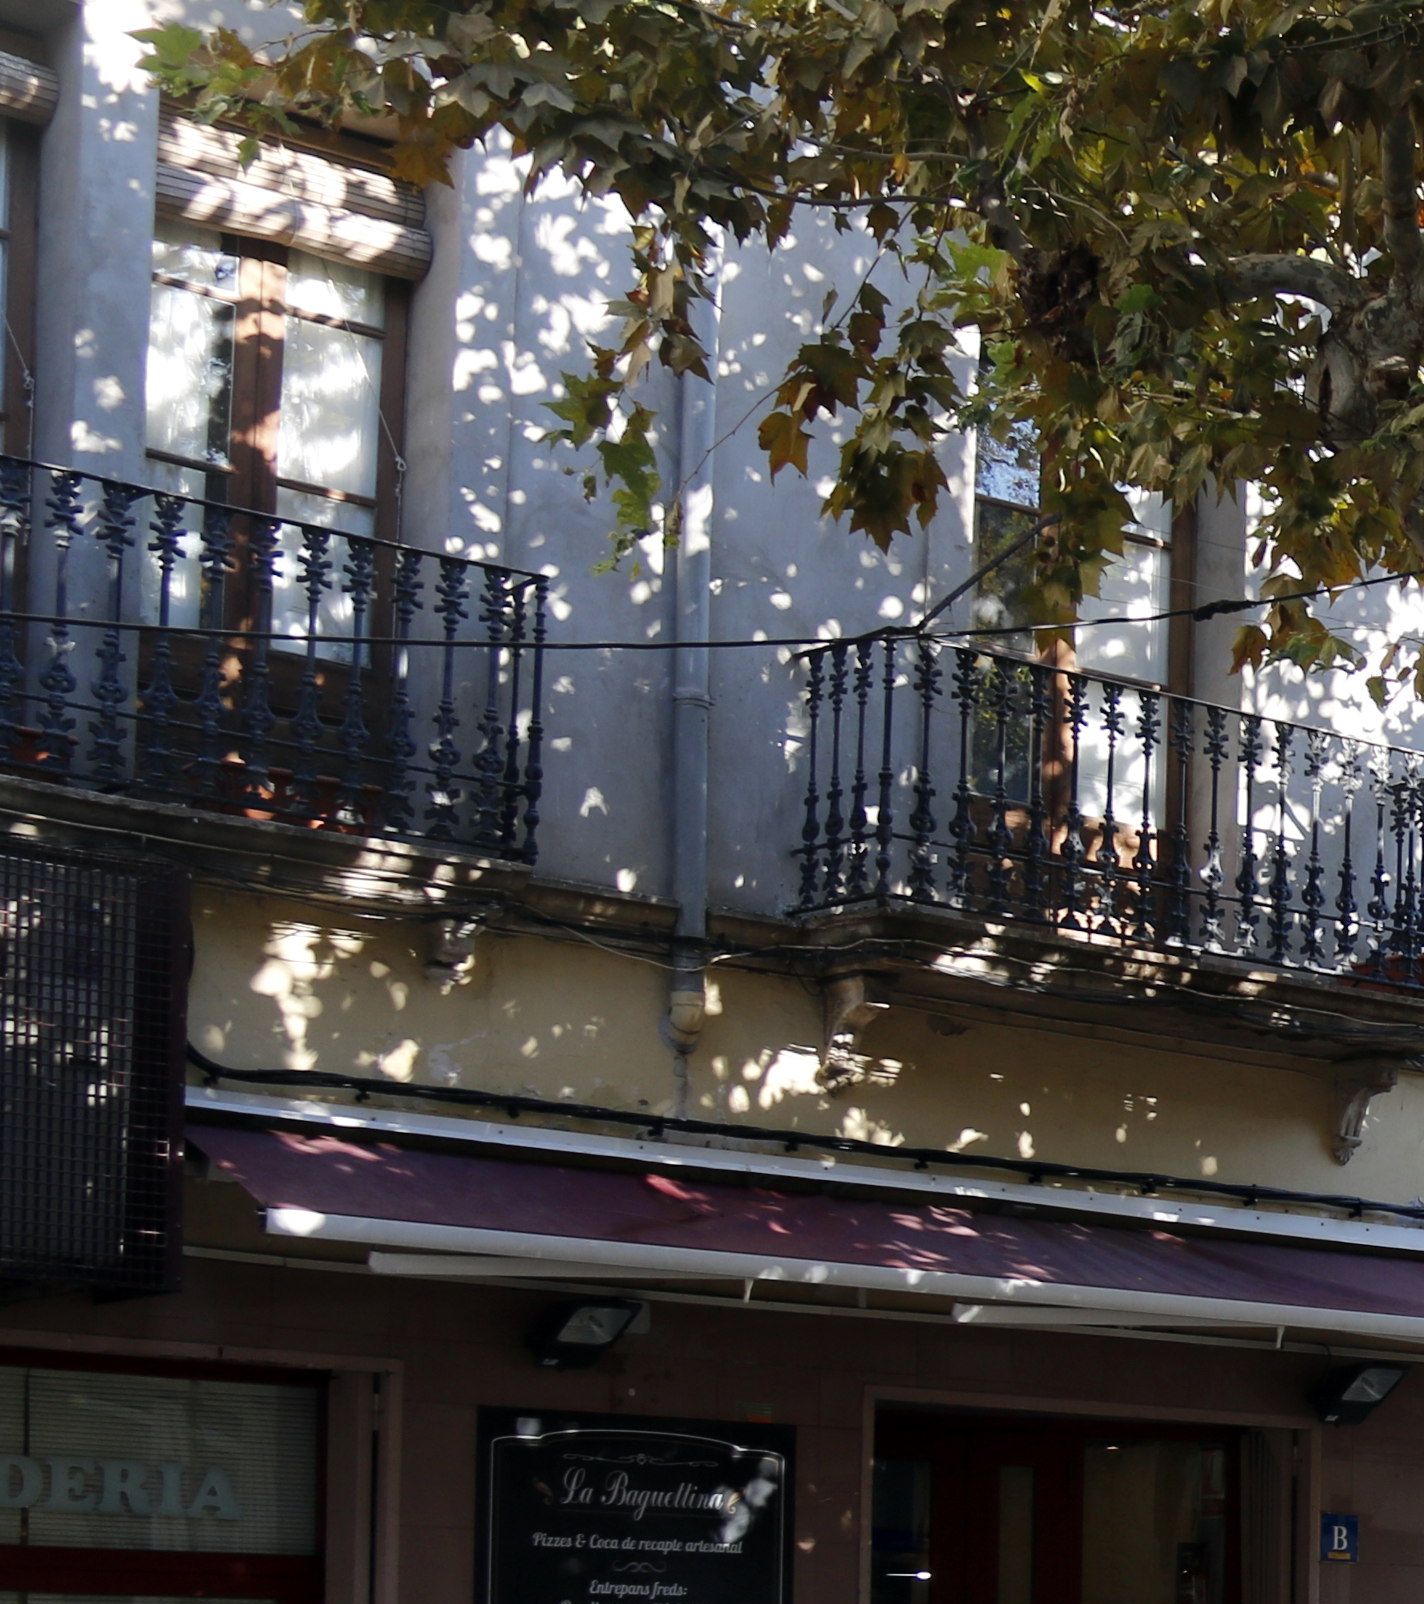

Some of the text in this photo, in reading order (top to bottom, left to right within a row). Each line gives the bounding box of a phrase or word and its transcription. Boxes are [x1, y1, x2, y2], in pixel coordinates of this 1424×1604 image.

[560, 1466, 593, 1504] La
[532, 1531, 743, 1554] Pizzes & Coca de recapte artesanal
[1332, 1525, 1348, 1551] B
[589, 1579, 688, 1599] Entrepans freds:
